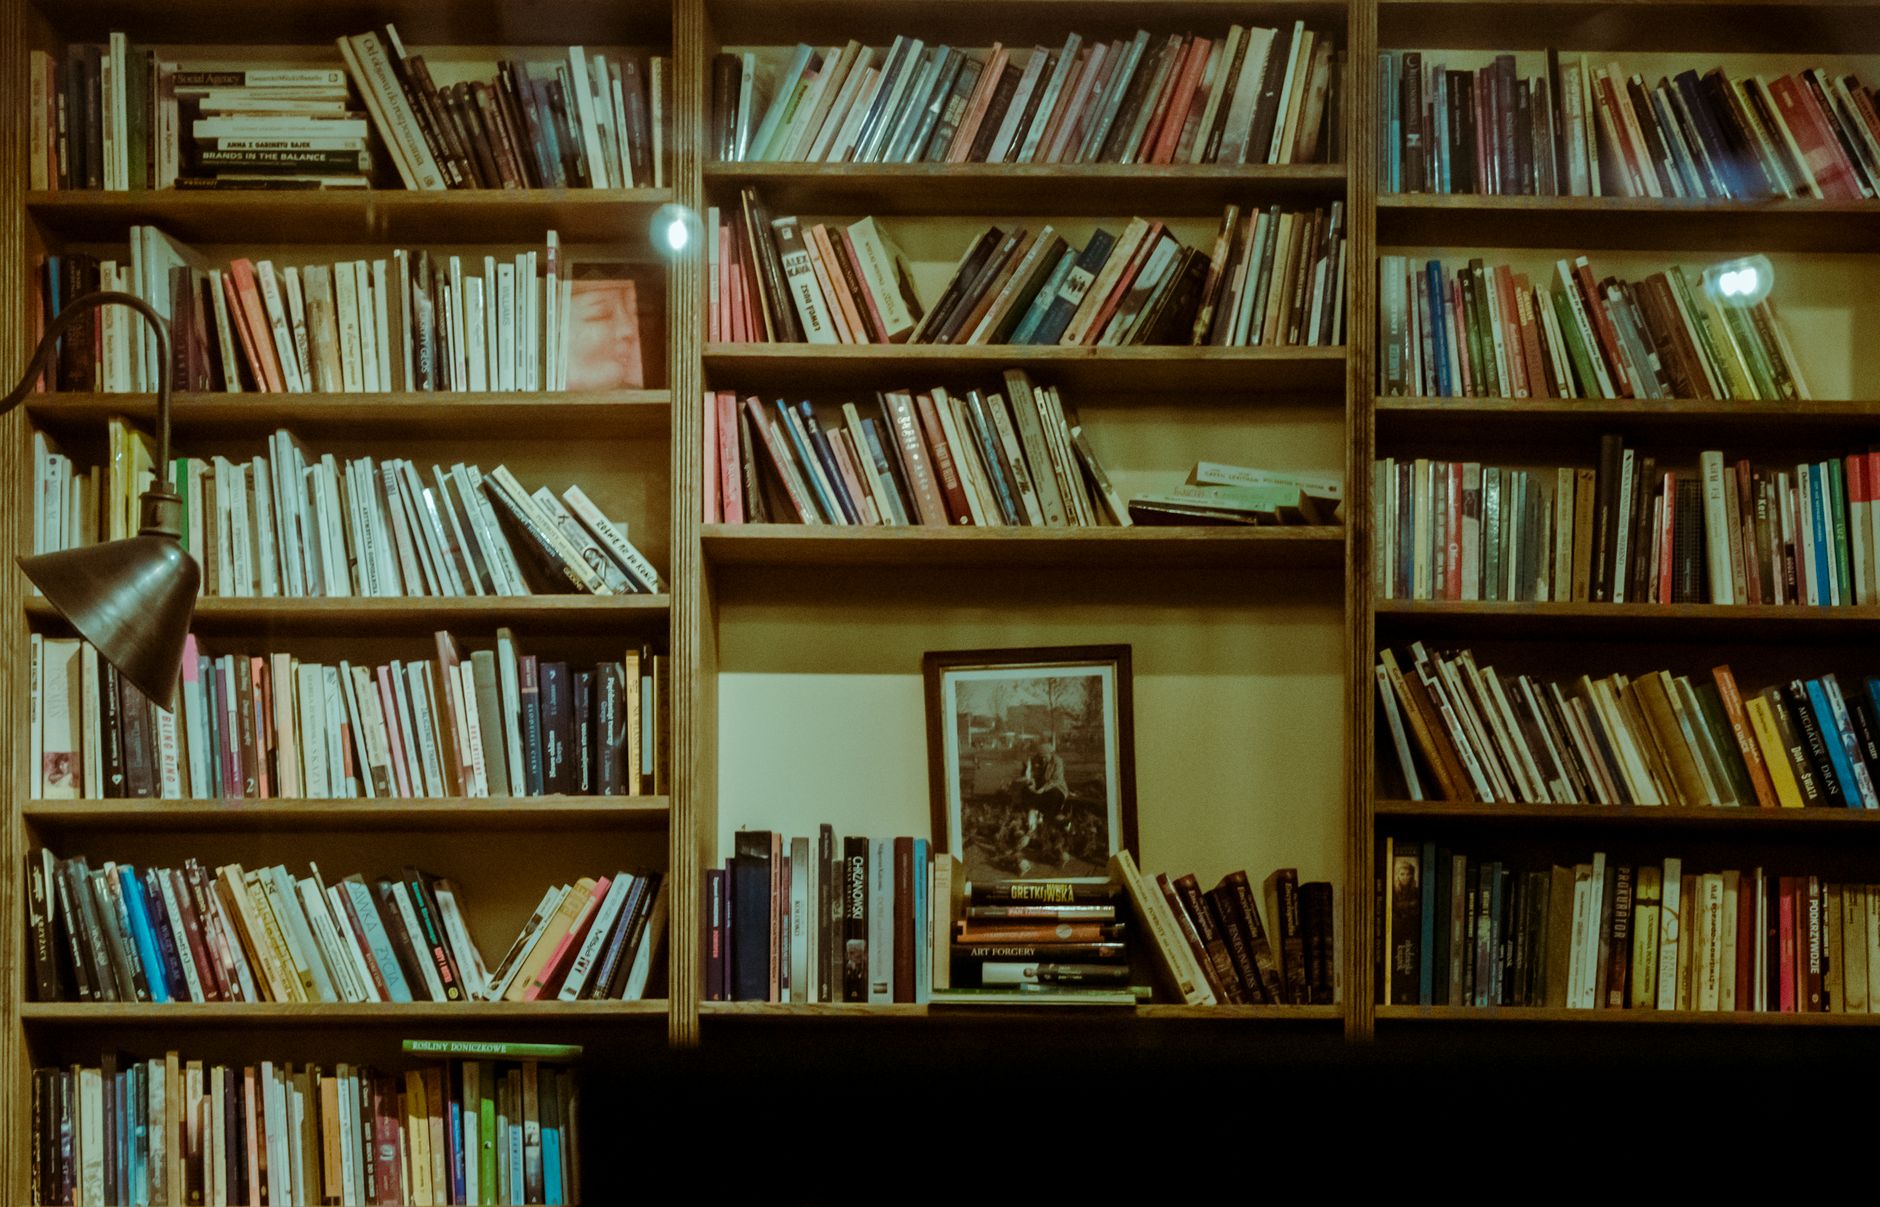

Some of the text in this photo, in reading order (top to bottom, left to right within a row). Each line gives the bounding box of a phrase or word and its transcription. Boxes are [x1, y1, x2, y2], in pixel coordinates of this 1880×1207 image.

[203, 152, 243, 160] BRANDS
[280, 154, 326, 162] BALANCE
[786, 255, 808, 266] ALEX
[787, 266, 811, 278] KAVA
[502, 285, 510, 326] WILLIAMS
[1758, 498, 1766, 519] Kerr
[1794, 704, 1824, 757] MICHALAK
[161, 715, 175, 782] BLING RING
[1790, 744, 1806, 763] DOM
[247, 778, 255, 793] 2
[852, 856, 863, 918] CHRZANOWSKI
[1011, 884, 1074, 902] GRETKOWSKA
[348, 878, 378, 933] DAWKA
[1612, 867, 1631, 938] PROKURATOR
[971, 947, 1036, 956] ART FORGERY
[412, 1040, 506, 1054] ROŚLINY DONICZKOWE
